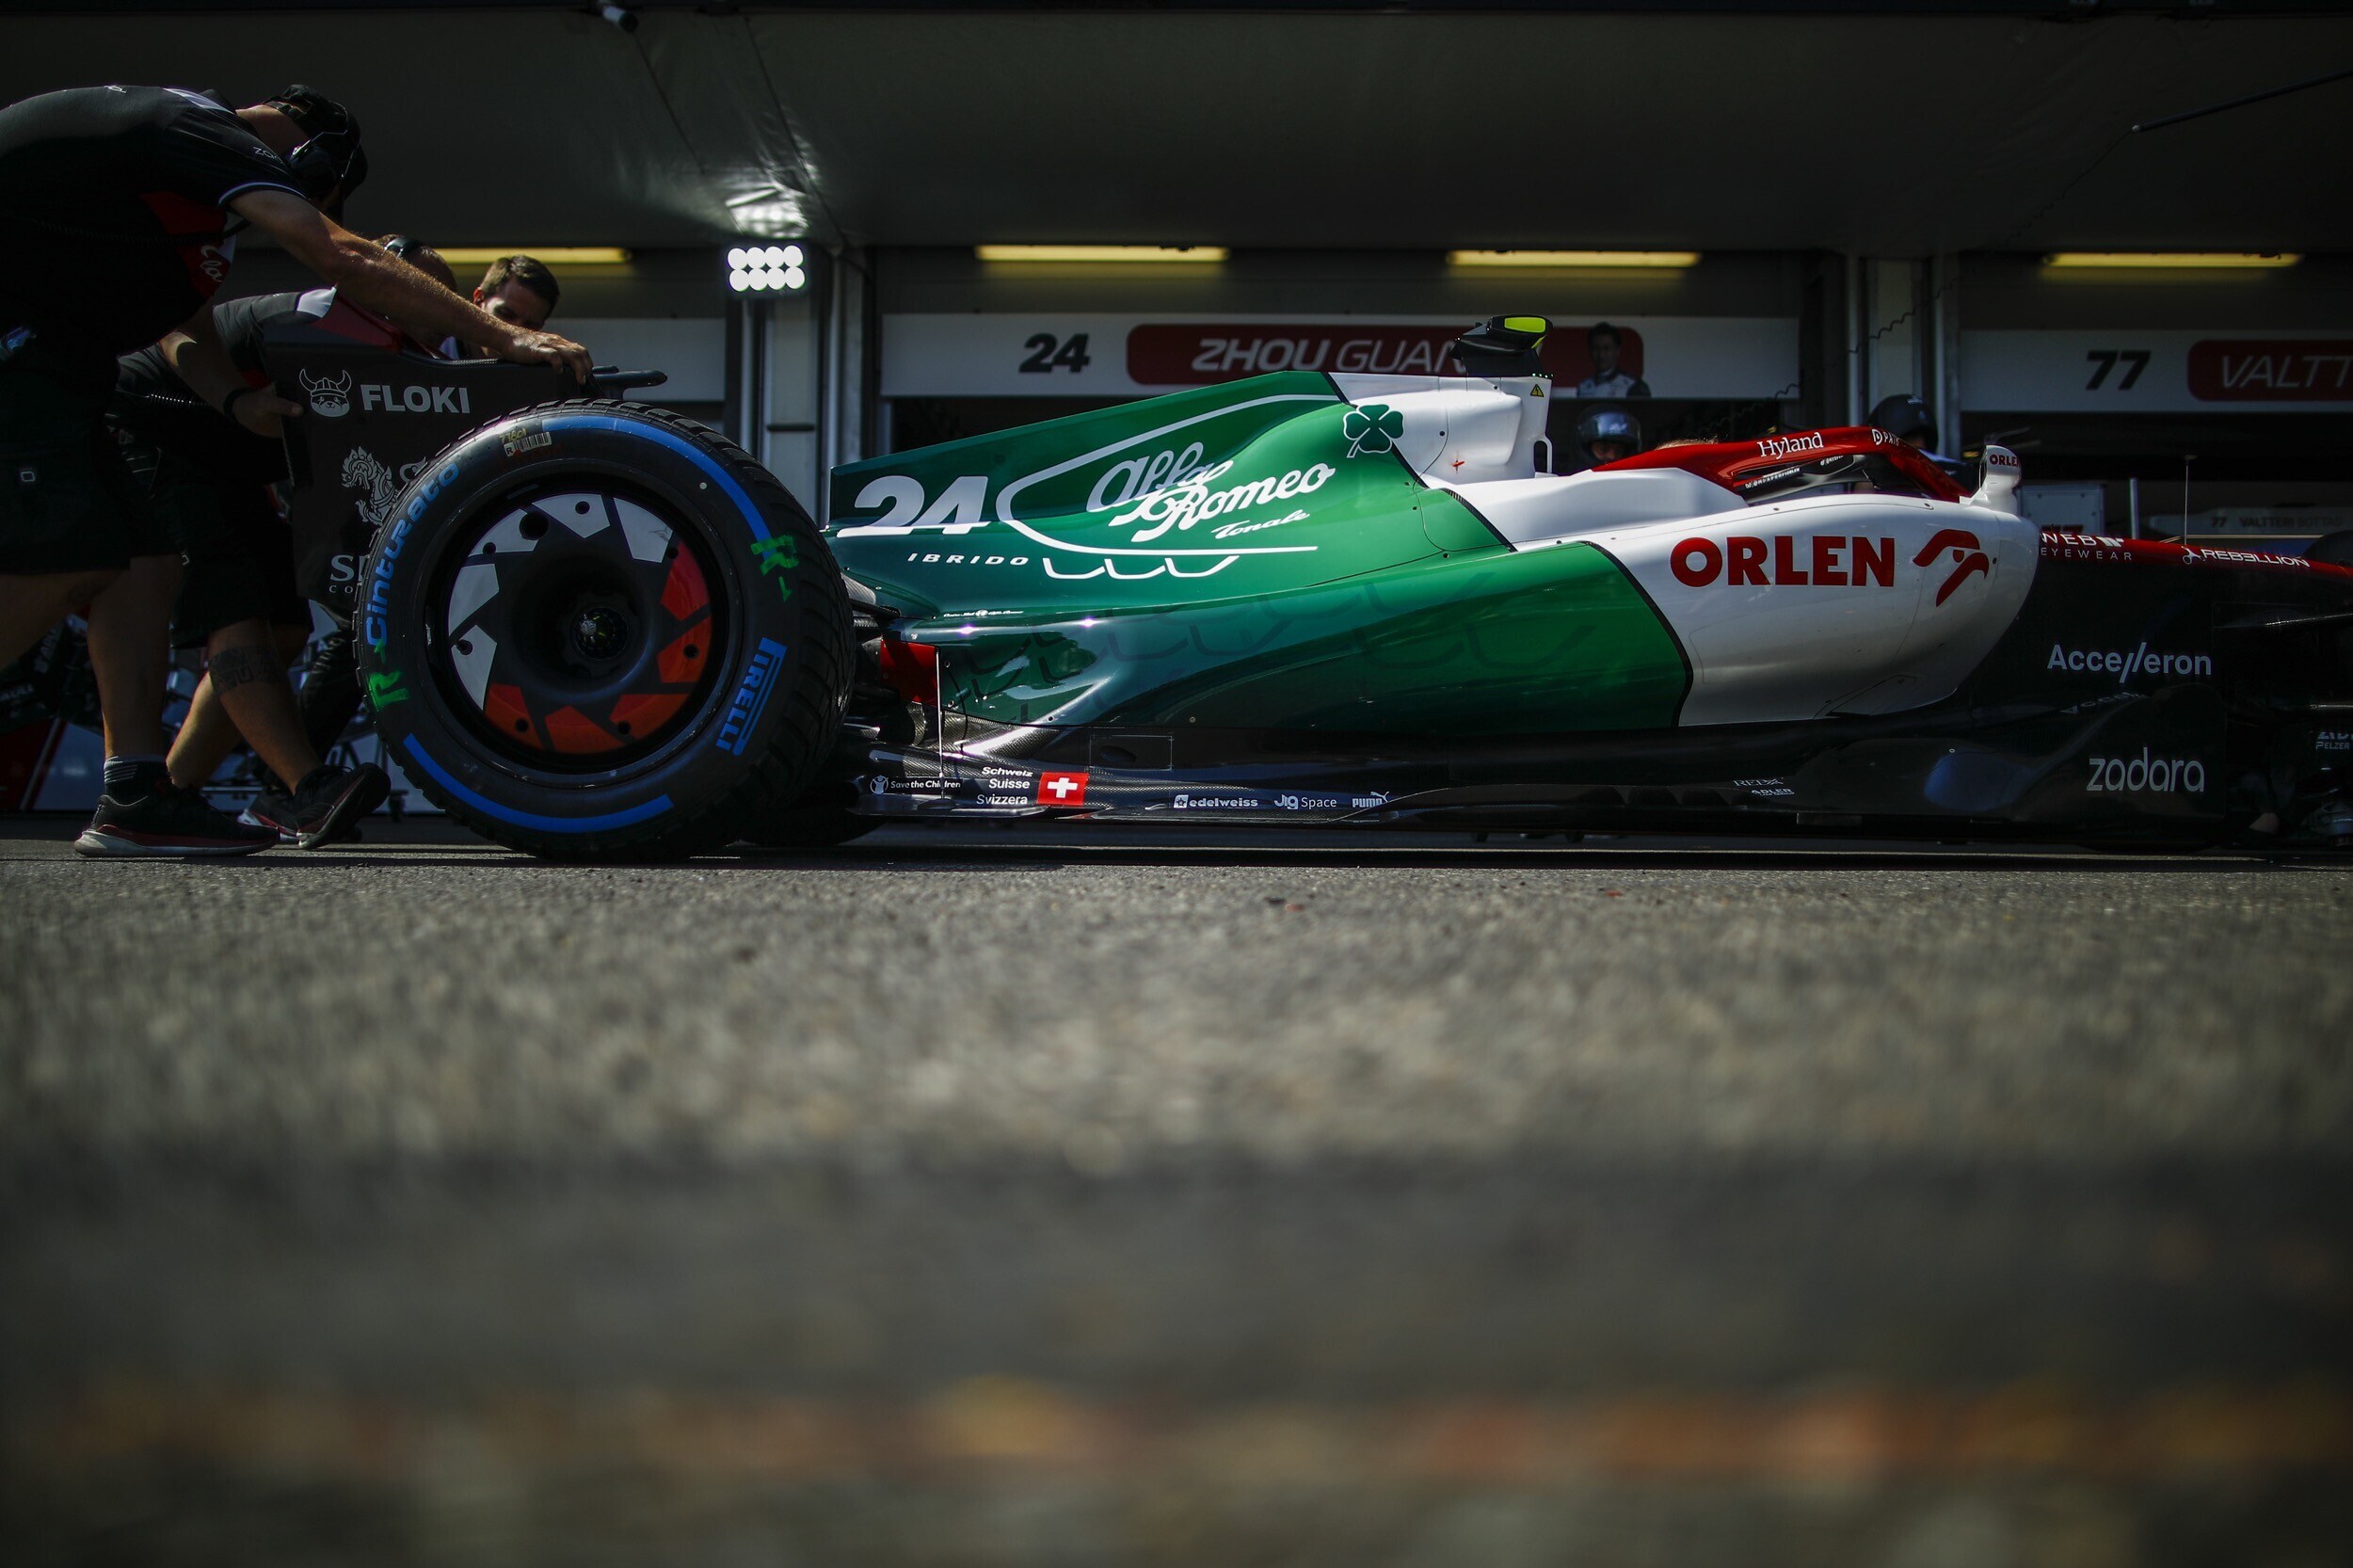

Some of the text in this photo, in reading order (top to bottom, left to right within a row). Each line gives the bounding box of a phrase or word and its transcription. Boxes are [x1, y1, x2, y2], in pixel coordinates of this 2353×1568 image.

[1018, 333, 1467, 375] 24 ZHOU GUAN
[2085, 349, 2152, 391] 77
[360, 384, 472, 414] FLOKI
[1756, 431, 1825, 460] Hyland
[1085, 440, 1234, 513] Alfa
[836, 474, 992, 538] 24
[1108, 462, 1337, 543] Romeo
[1210, 508, 1311, 539] Tonale
[365, 462, 460, 647] Cinturato
[907, 552, 1029, 566] IBRIDO
[1670, 536, 1895, 588] ORLEN
[2041, 548, 2132, 561] EYEWEAR
[2200, 548, 2312, 568] REBELLION
[714, 636, 788, 757] PIRELLI
[982, 766, 1033, 777] Schweiz
[988, 778, 1031, 790] Suisse
[2086, 746, 2205, 792] zadara
[890, 780, 910, 789] Save
[910, 780, 924, 789] the
[976, 793, 1028, 806] Svizzera
[1189, 797, 1258, 808] edelweiss
[1301, 796, 1337, 810] Space
